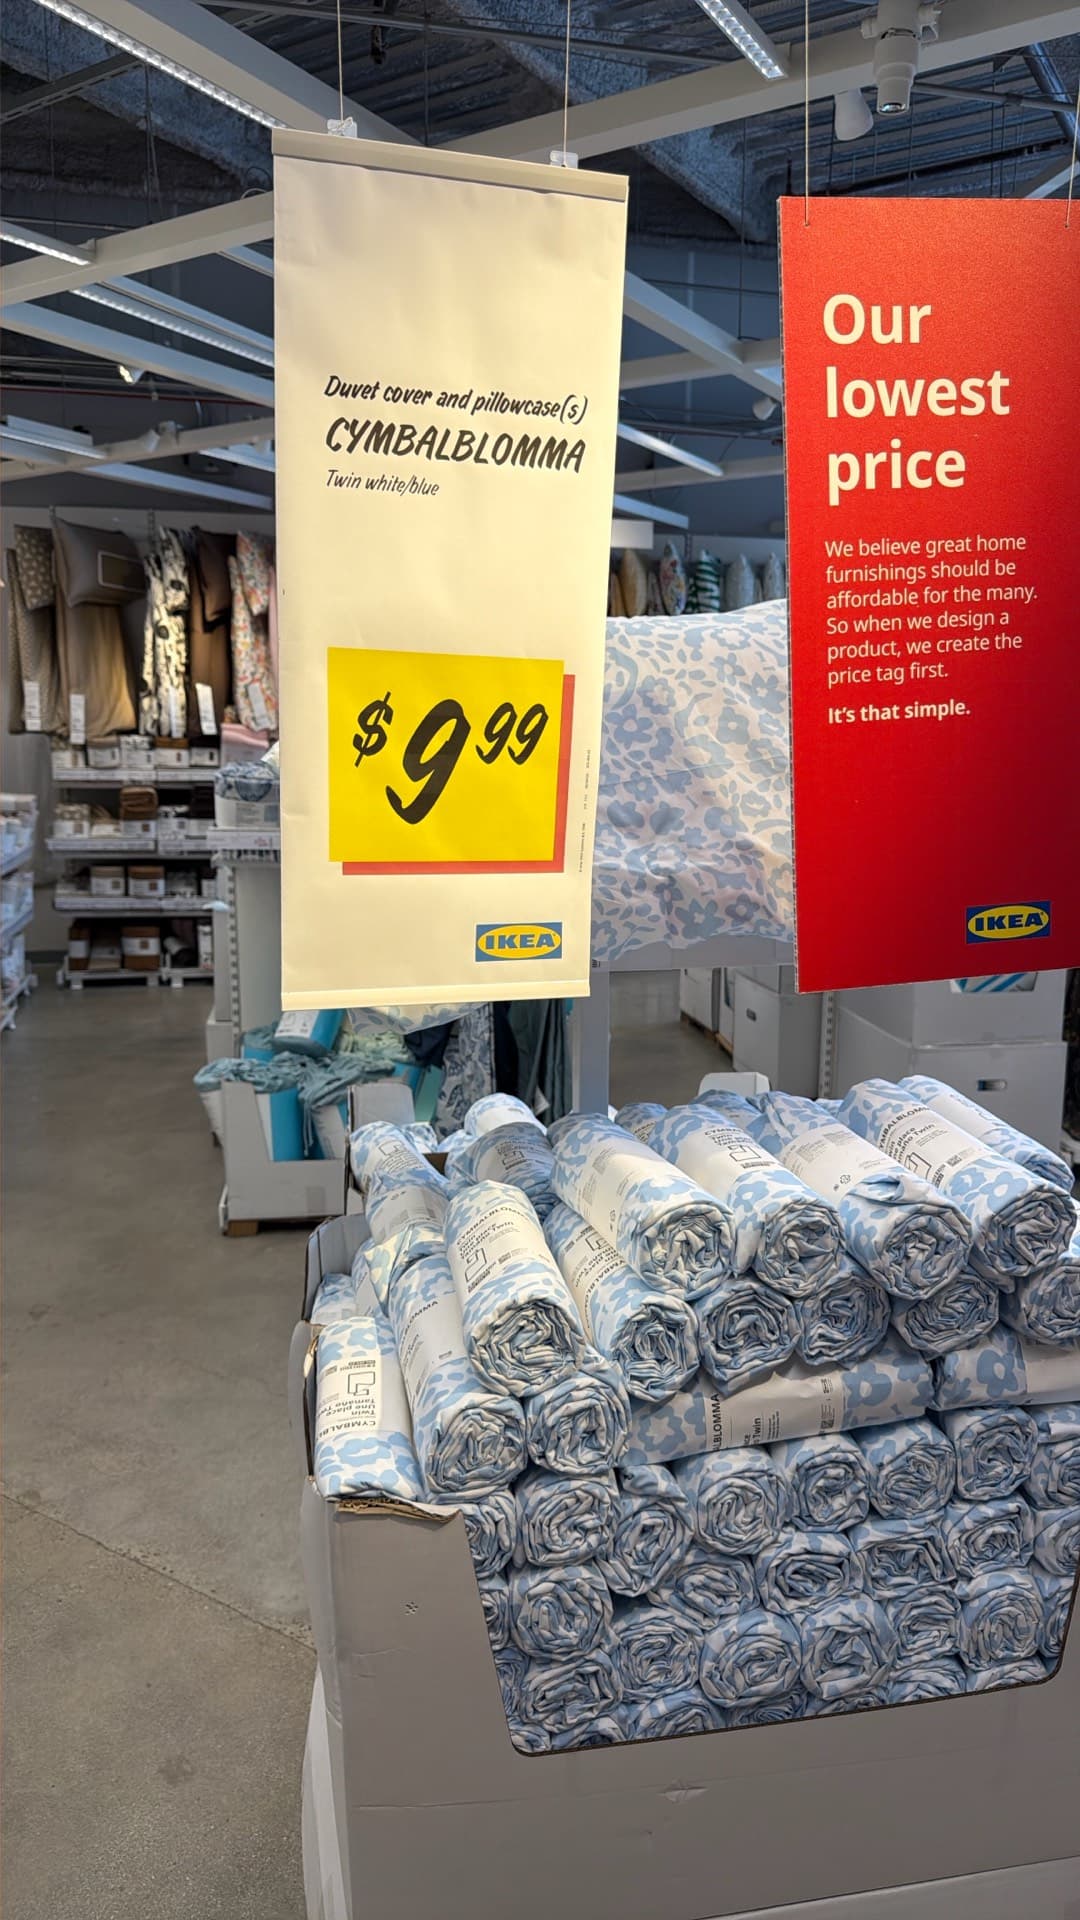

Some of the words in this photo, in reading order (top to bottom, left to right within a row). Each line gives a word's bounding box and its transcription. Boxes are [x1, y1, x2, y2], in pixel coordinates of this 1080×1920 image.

[823, 294, 931, 344] Our
[324, 375, 380, 399] Duvet
[383, 386, 432, 406] cover
[437, 389, 473, 410] and
[471, 391, 588, 425] pillowcase(s)
[826, 366, 1010, 418] lowest
[325, 417, 586, 473] CYMBALBLOMMA
[326, 469, 361, 489] Twin
[366, 475, 440, 497] white/blue
[828, 438, 966, 506] price
[825, 541, 853, 558] We
[859, 538, 920, 556] believe
[926, 536, 972, 559] great
[977, 535, 1026, 552] home
[826, 563, 926, 584] furnishings
[931, 559, 989, 578] should
[995, 559, 1016, 576] be
[827, 588, 918, 609] affordable
[923, 587, 948, 604] for
[953, 585, 981, 603] the
[987, 585, 1038, 604] many.
[827, 617, 848, 634] So
[854, 614, 901, 632] when
[907, 615, 932, 629] we
[937, 610, 994, 630] design
[999, 612, 1009, 624] a
[828, 640, 901, 664] product,
[907, 640, 931, 654] we
[937, 635, 990, 653] create
[995, 633, 1022, 649] the
[828, 667, 871, 689] price
[876, 664, 904, 685] tag
[910, 662, 948, 680] first.
[860, 704, 900, 722] that
[905, 699, 970, 721] simple.
[975, 912, 1043, 932] IKEA
[486, 933, 555, 949] IKEA
[879, 1106, 930, 1148] YMBALBLOM
[710, 1393, 722, 1451] LBLOMMA
[752, 1417, 761, 1438] Twin
